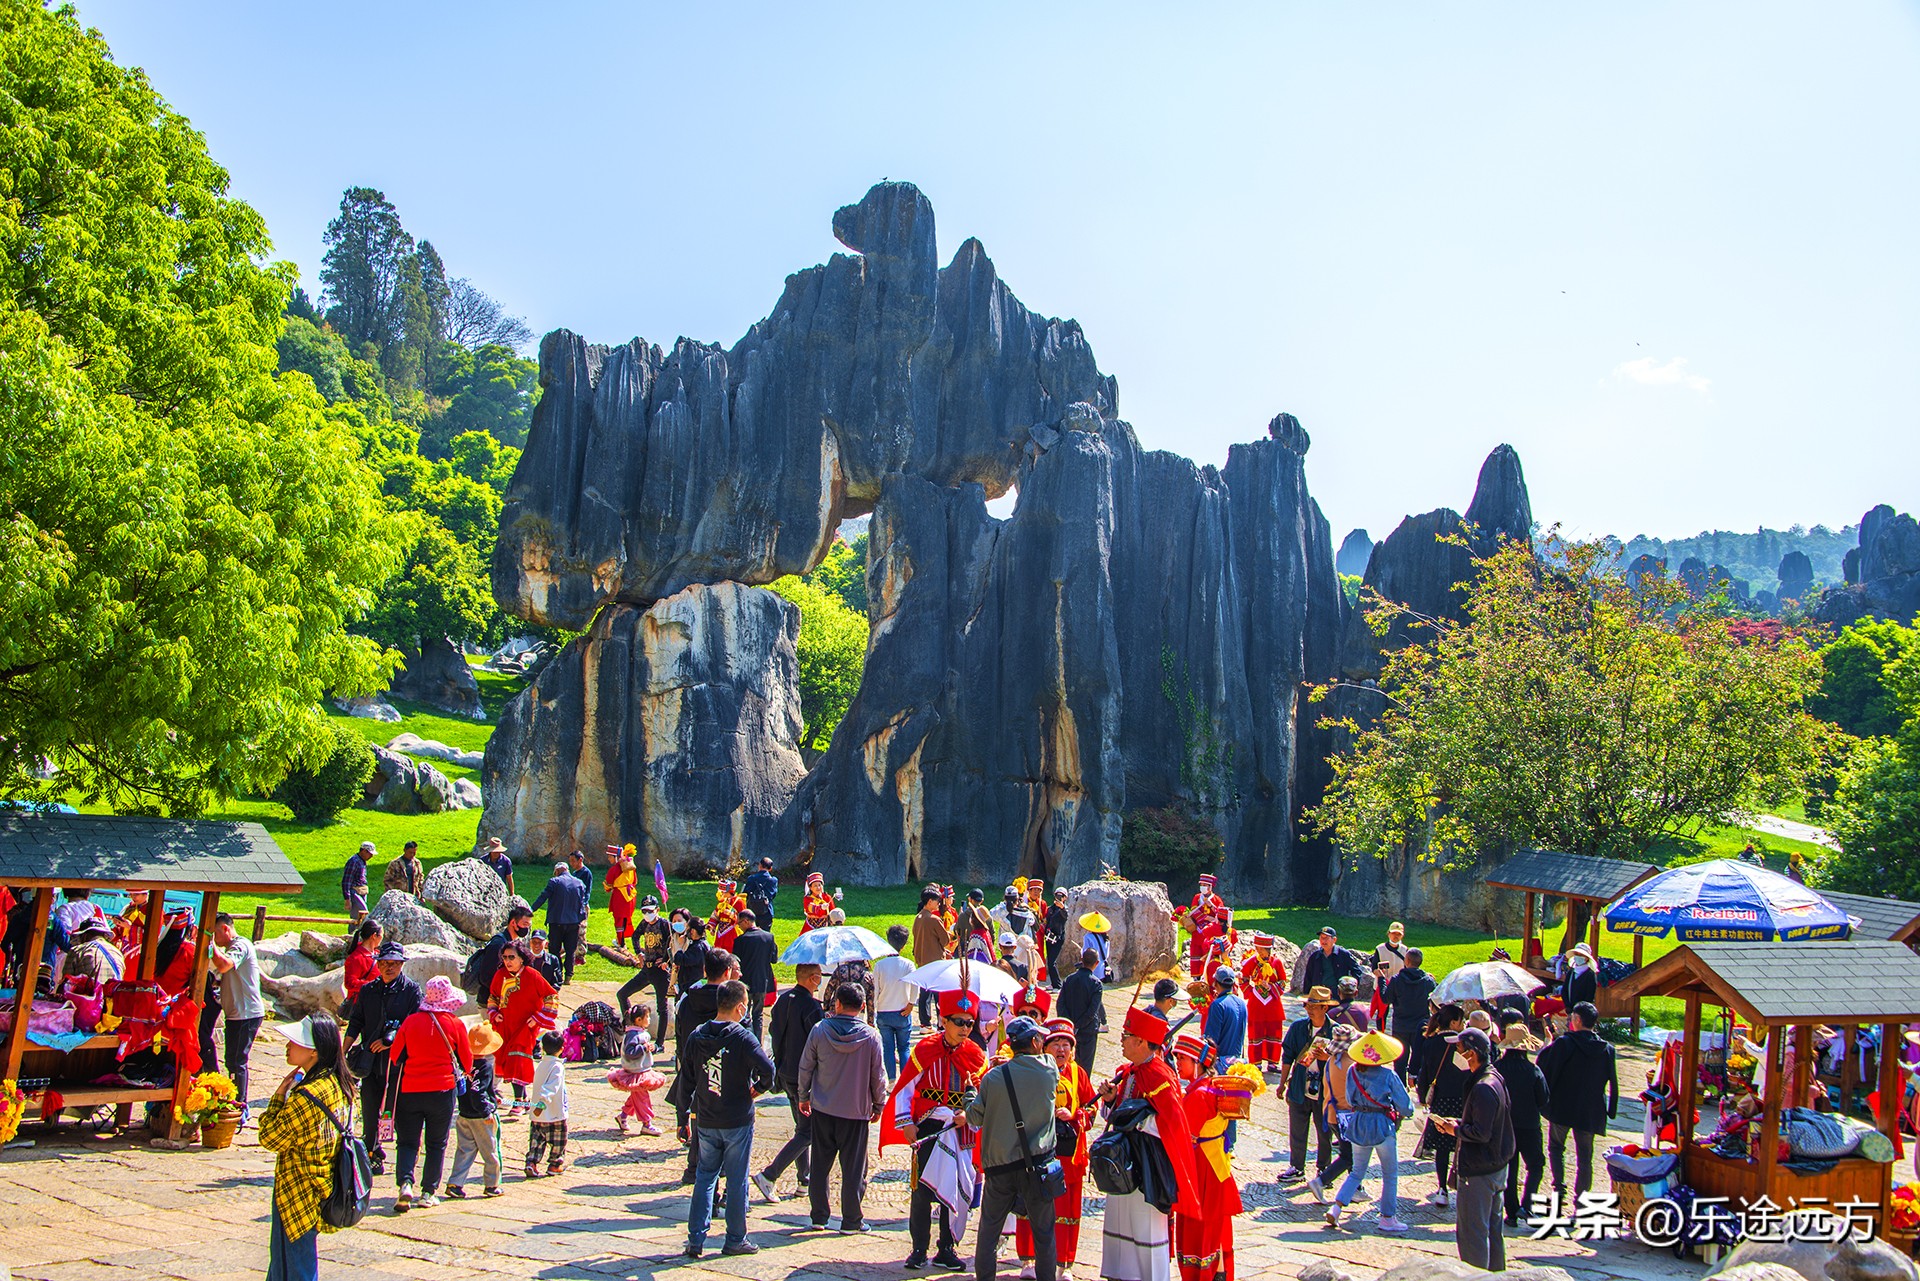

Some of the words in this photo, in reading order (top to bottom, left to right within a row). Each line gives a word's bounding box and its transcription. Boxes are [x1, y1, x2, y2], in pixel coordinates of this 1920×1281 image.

[1685, 929, 1763, 940] 红牛维生素功能饮料
